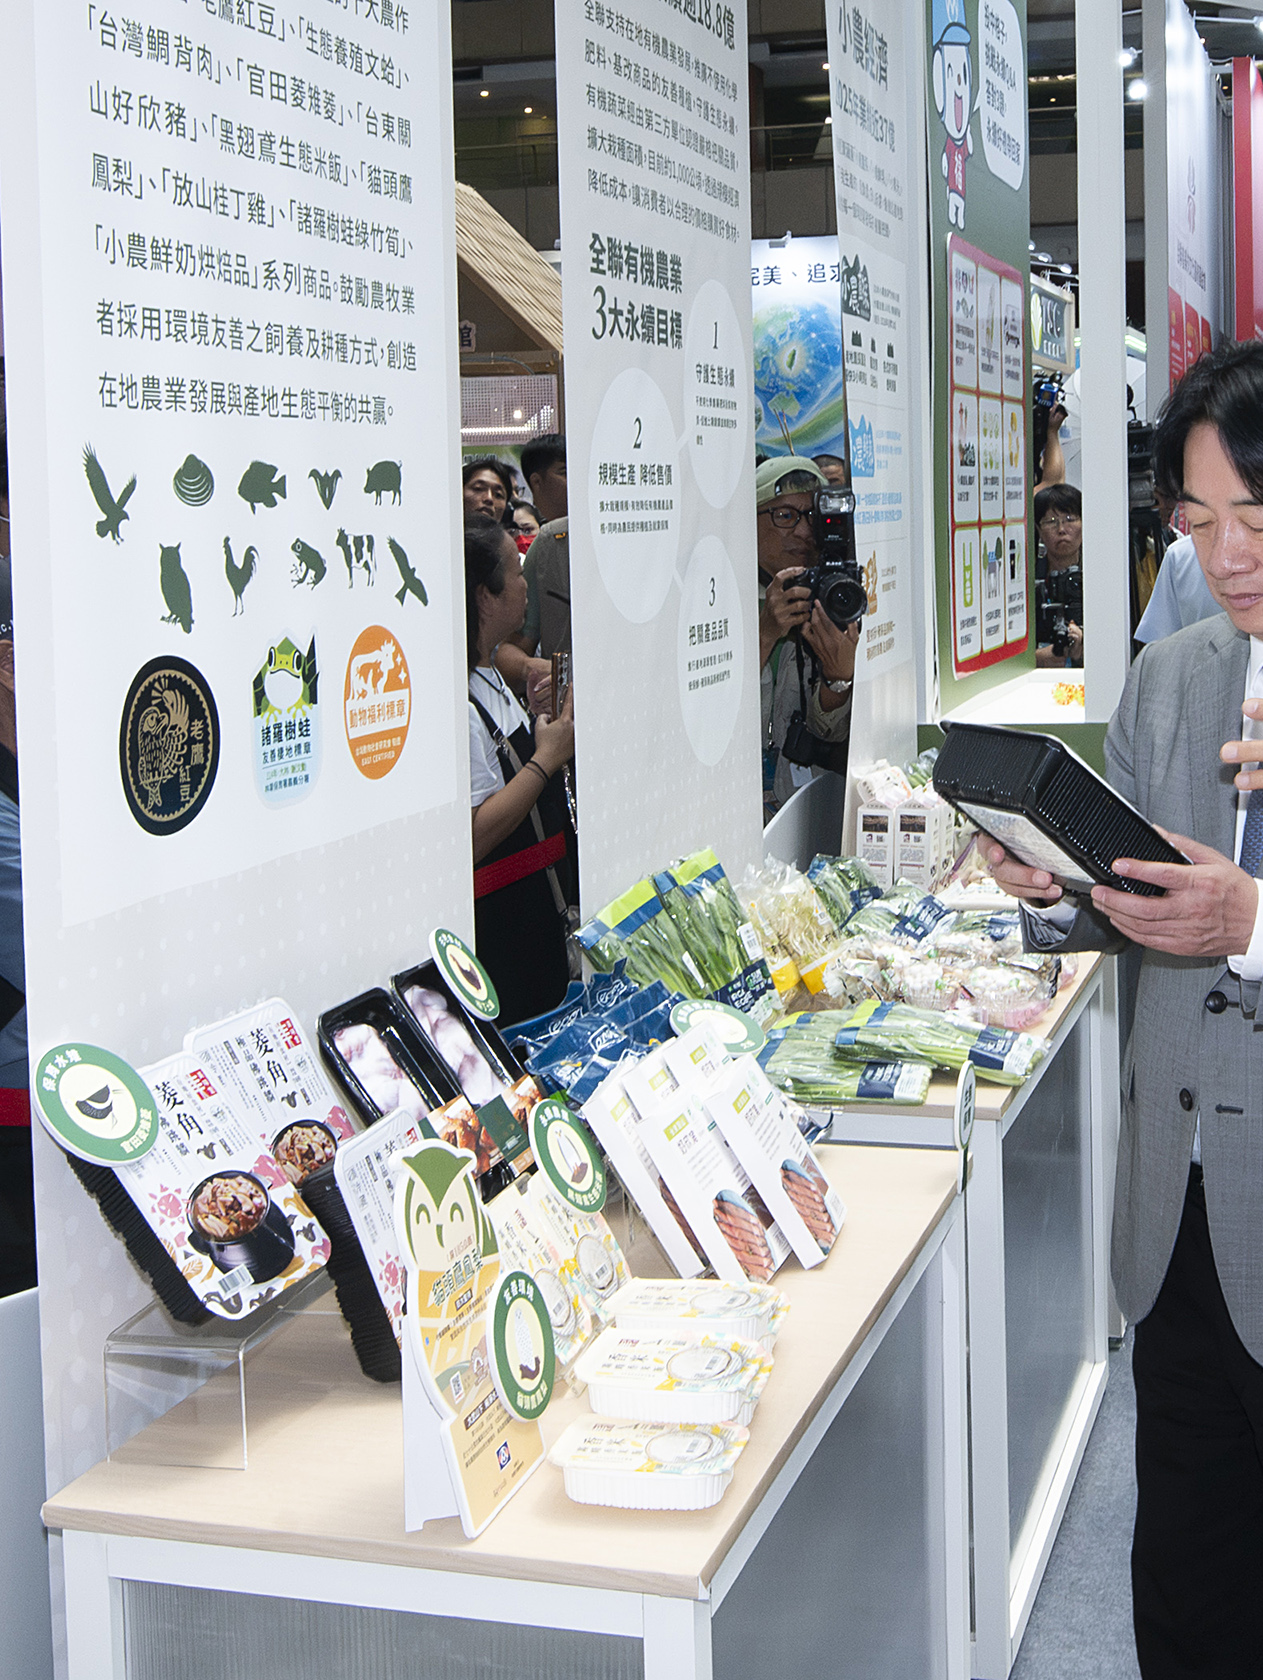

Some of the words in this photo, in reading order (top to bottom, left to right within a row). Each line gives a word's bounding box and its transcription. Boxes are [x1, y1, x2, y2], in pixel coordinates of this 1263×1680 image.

[588, 232, 683, 294] 全聯有機農業
[591, 285, 684, 350] 3大永續目標
[632, 416, 643, 450] 2
[708, 577, 716, 607] 3
[260, 716, 312, 748] 諸羅樹蛙
[249, 1028, 289, 1088] 菱角
[155, 1081, 205, 1141] 菱角
